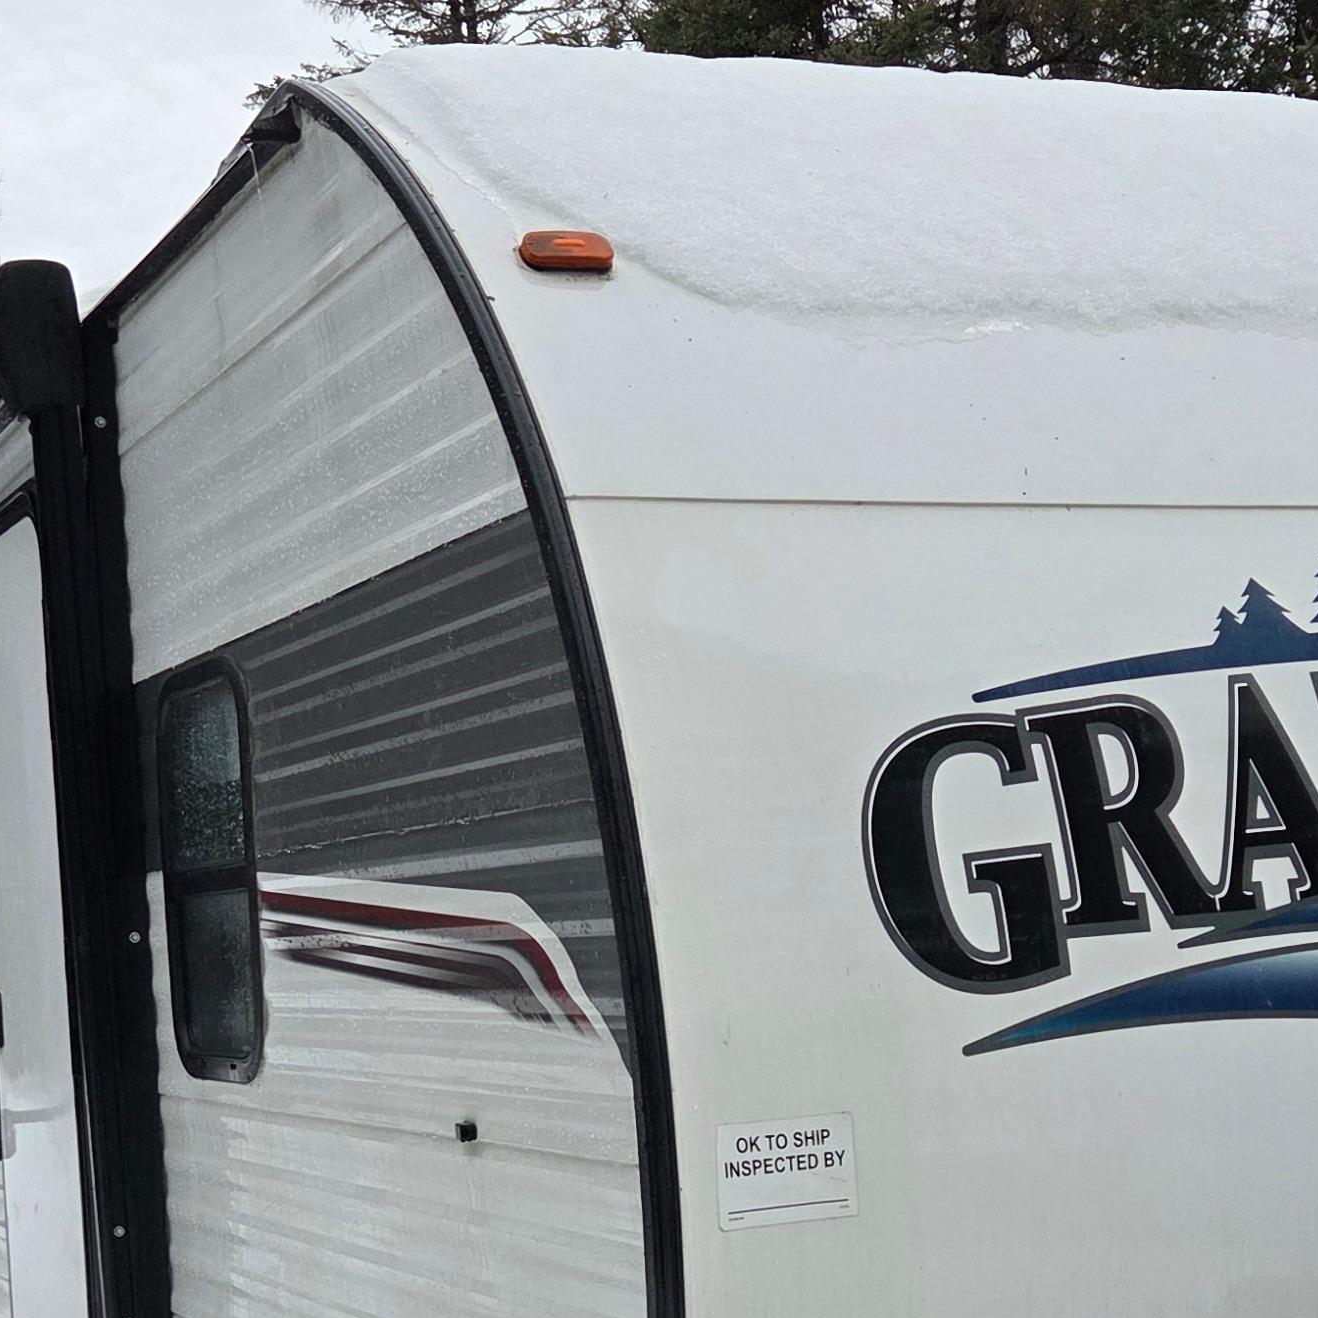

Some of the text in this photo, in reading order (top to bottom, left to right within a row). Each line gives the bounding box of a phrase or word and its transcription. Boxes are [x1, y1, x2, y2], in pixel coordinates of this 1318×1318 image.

[735, 1128, 832, 1154] OK TO SHIP
[724, 1150, 845, 1178] INSPECTED BY
